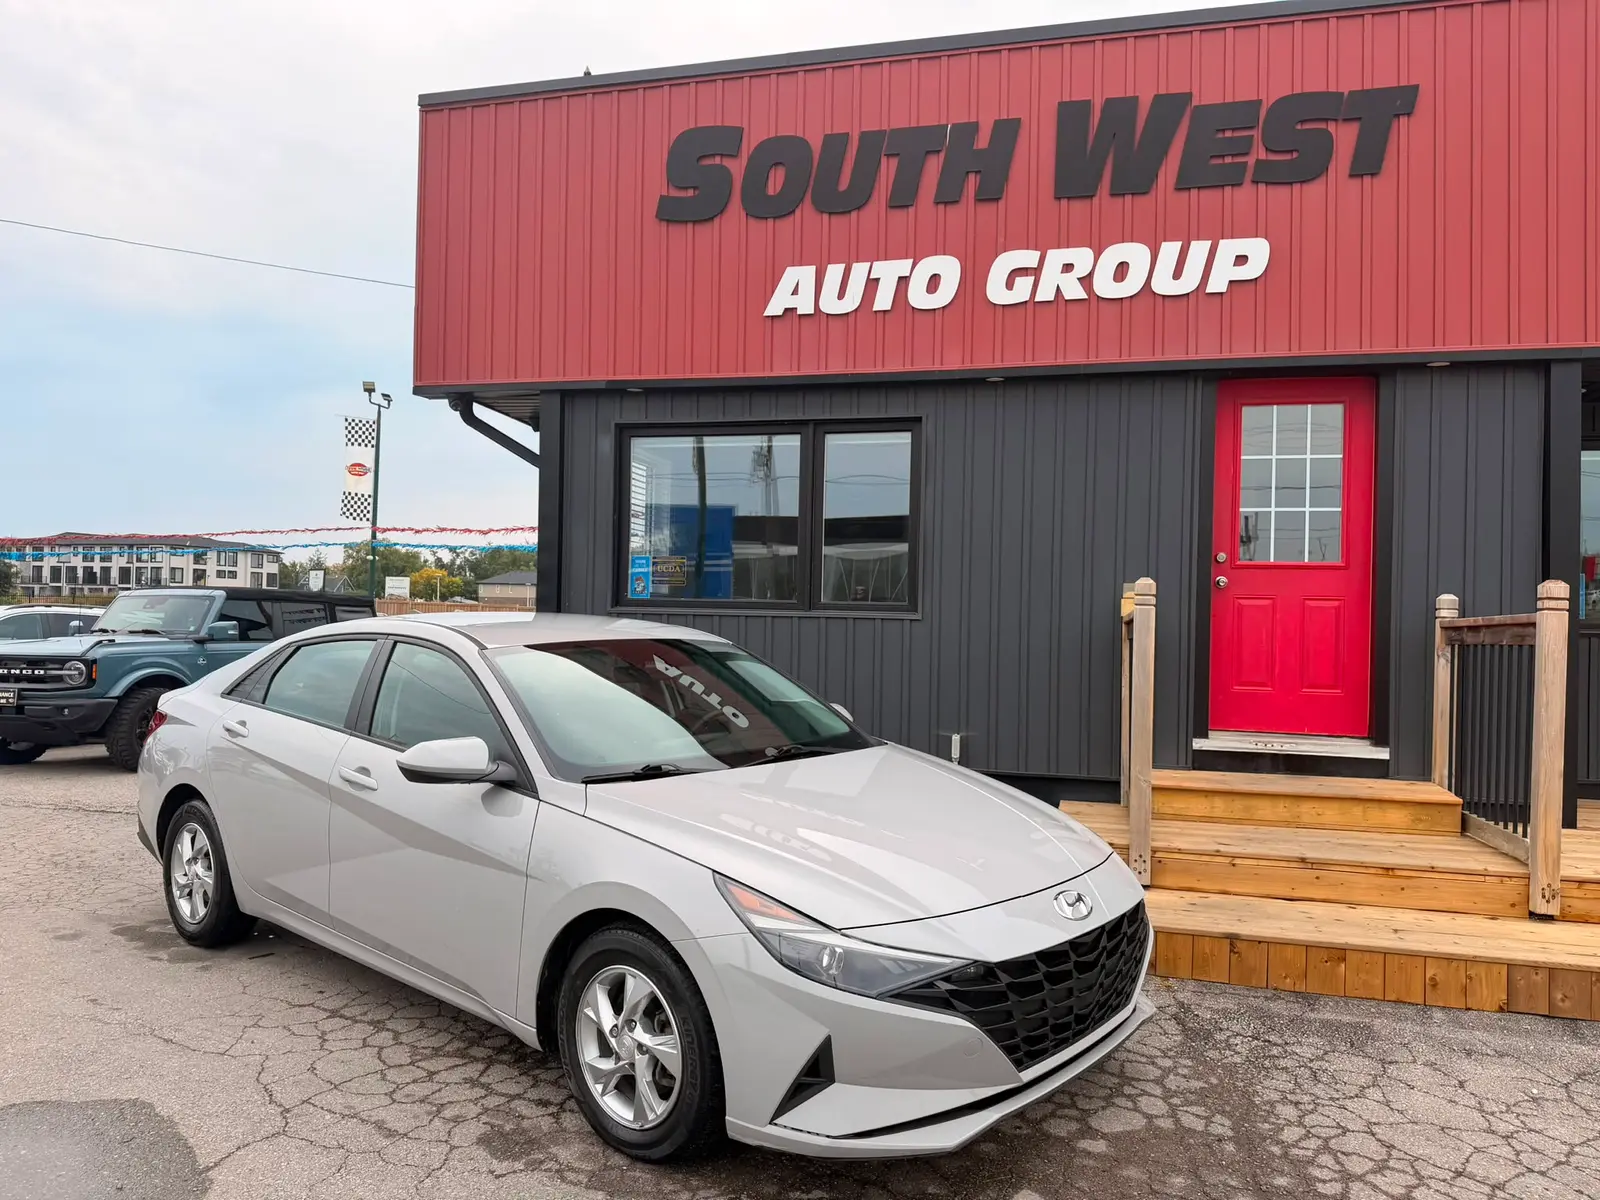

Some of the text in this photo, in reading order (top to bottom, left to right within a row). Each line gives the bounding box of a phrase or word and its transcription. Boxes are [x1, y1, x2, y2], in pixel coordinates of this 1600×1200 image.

[655, 84, 1419, 222] SOUTH WEST
[763, 237, 1271, 316] AUTO GROUP
